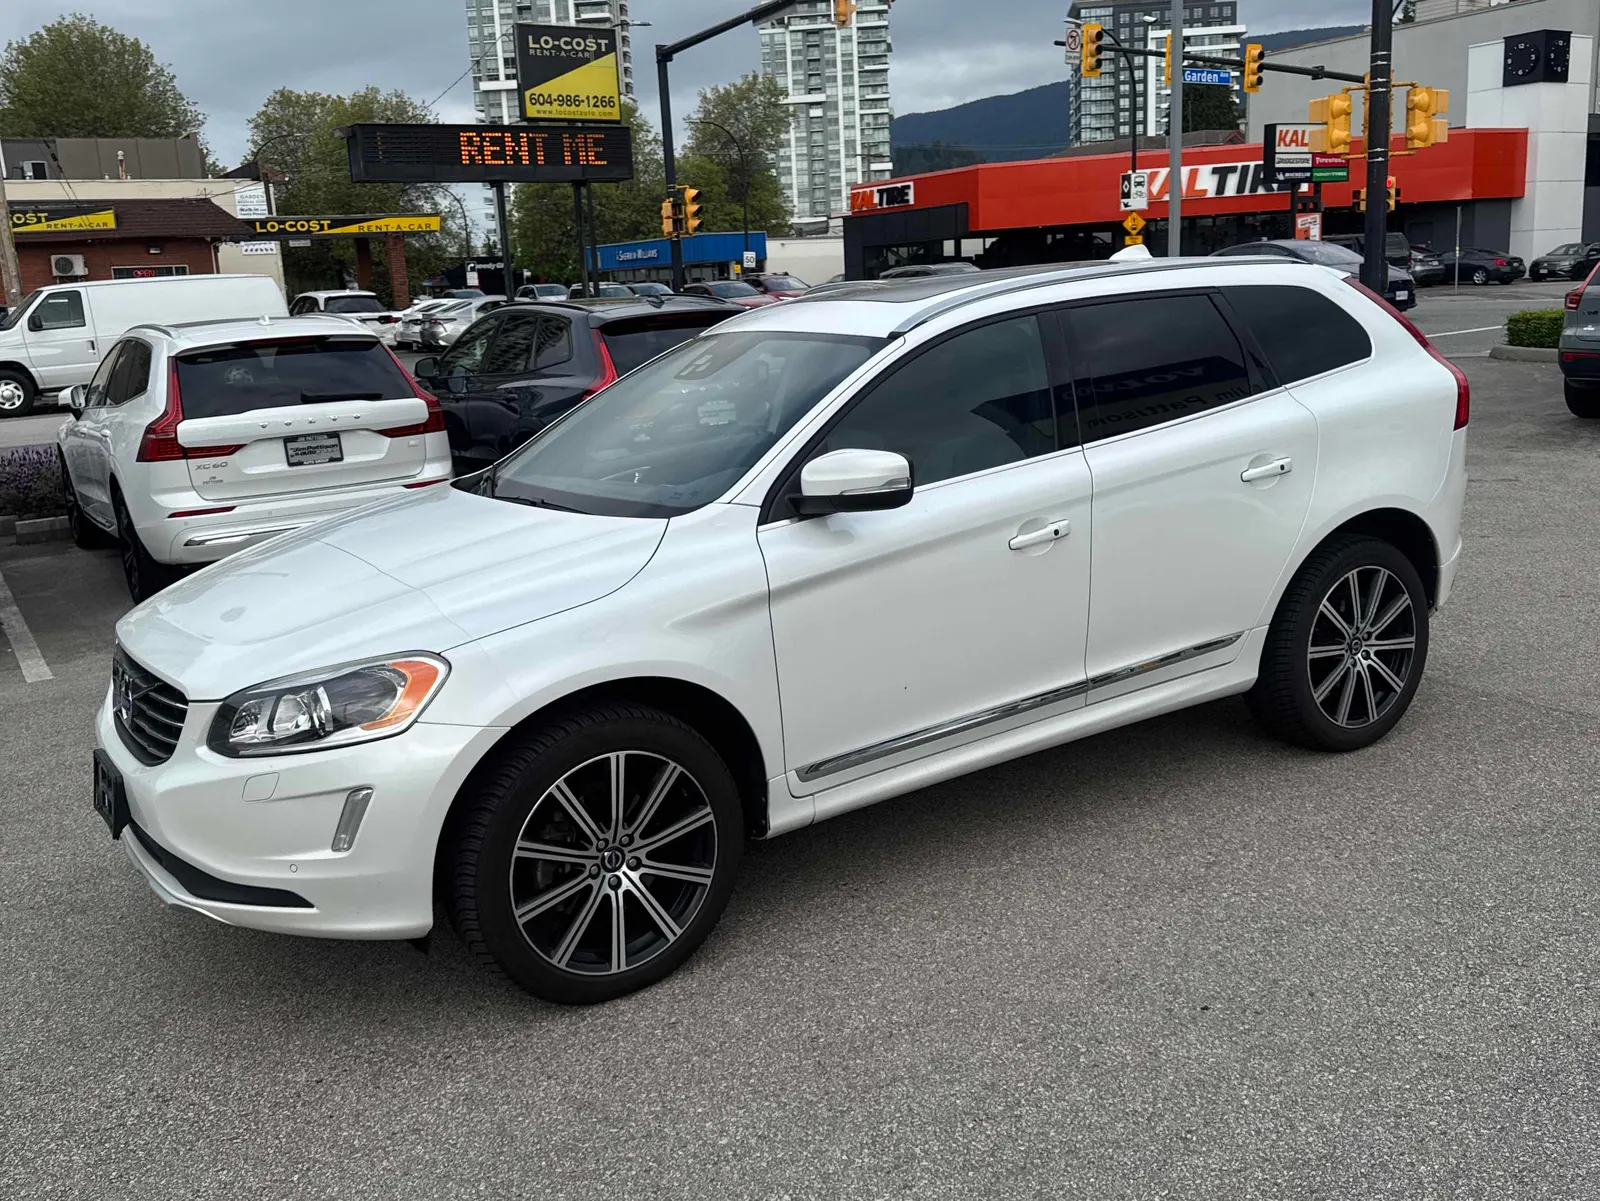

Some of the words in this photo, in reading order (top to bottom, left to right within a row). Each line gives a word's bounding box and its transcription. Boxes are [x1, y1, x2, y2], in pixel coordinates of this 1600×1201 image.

[528, 35, 608, 51] LO-COST
[529, 49, 590, 58] RENT-A-CAR
[1184, 71, 1219, 83] Garden
[529, 93, 615, 108] 604-986-1266
[536, 109, 614, 117] www.locostauto.com
[1277, 130, 1308, 147] KAL
[460, 132, 548, 164] RENT
[562, 133, 607, 164] ME
[877, 184, 911, 207] TIRE
[255, 220, 331, 232] LO-COST
[358, 223, 432, 232] RENT-A-CAR
[745, 256, 755, 264] 50
[133, 269, 155, 278] OPEN
